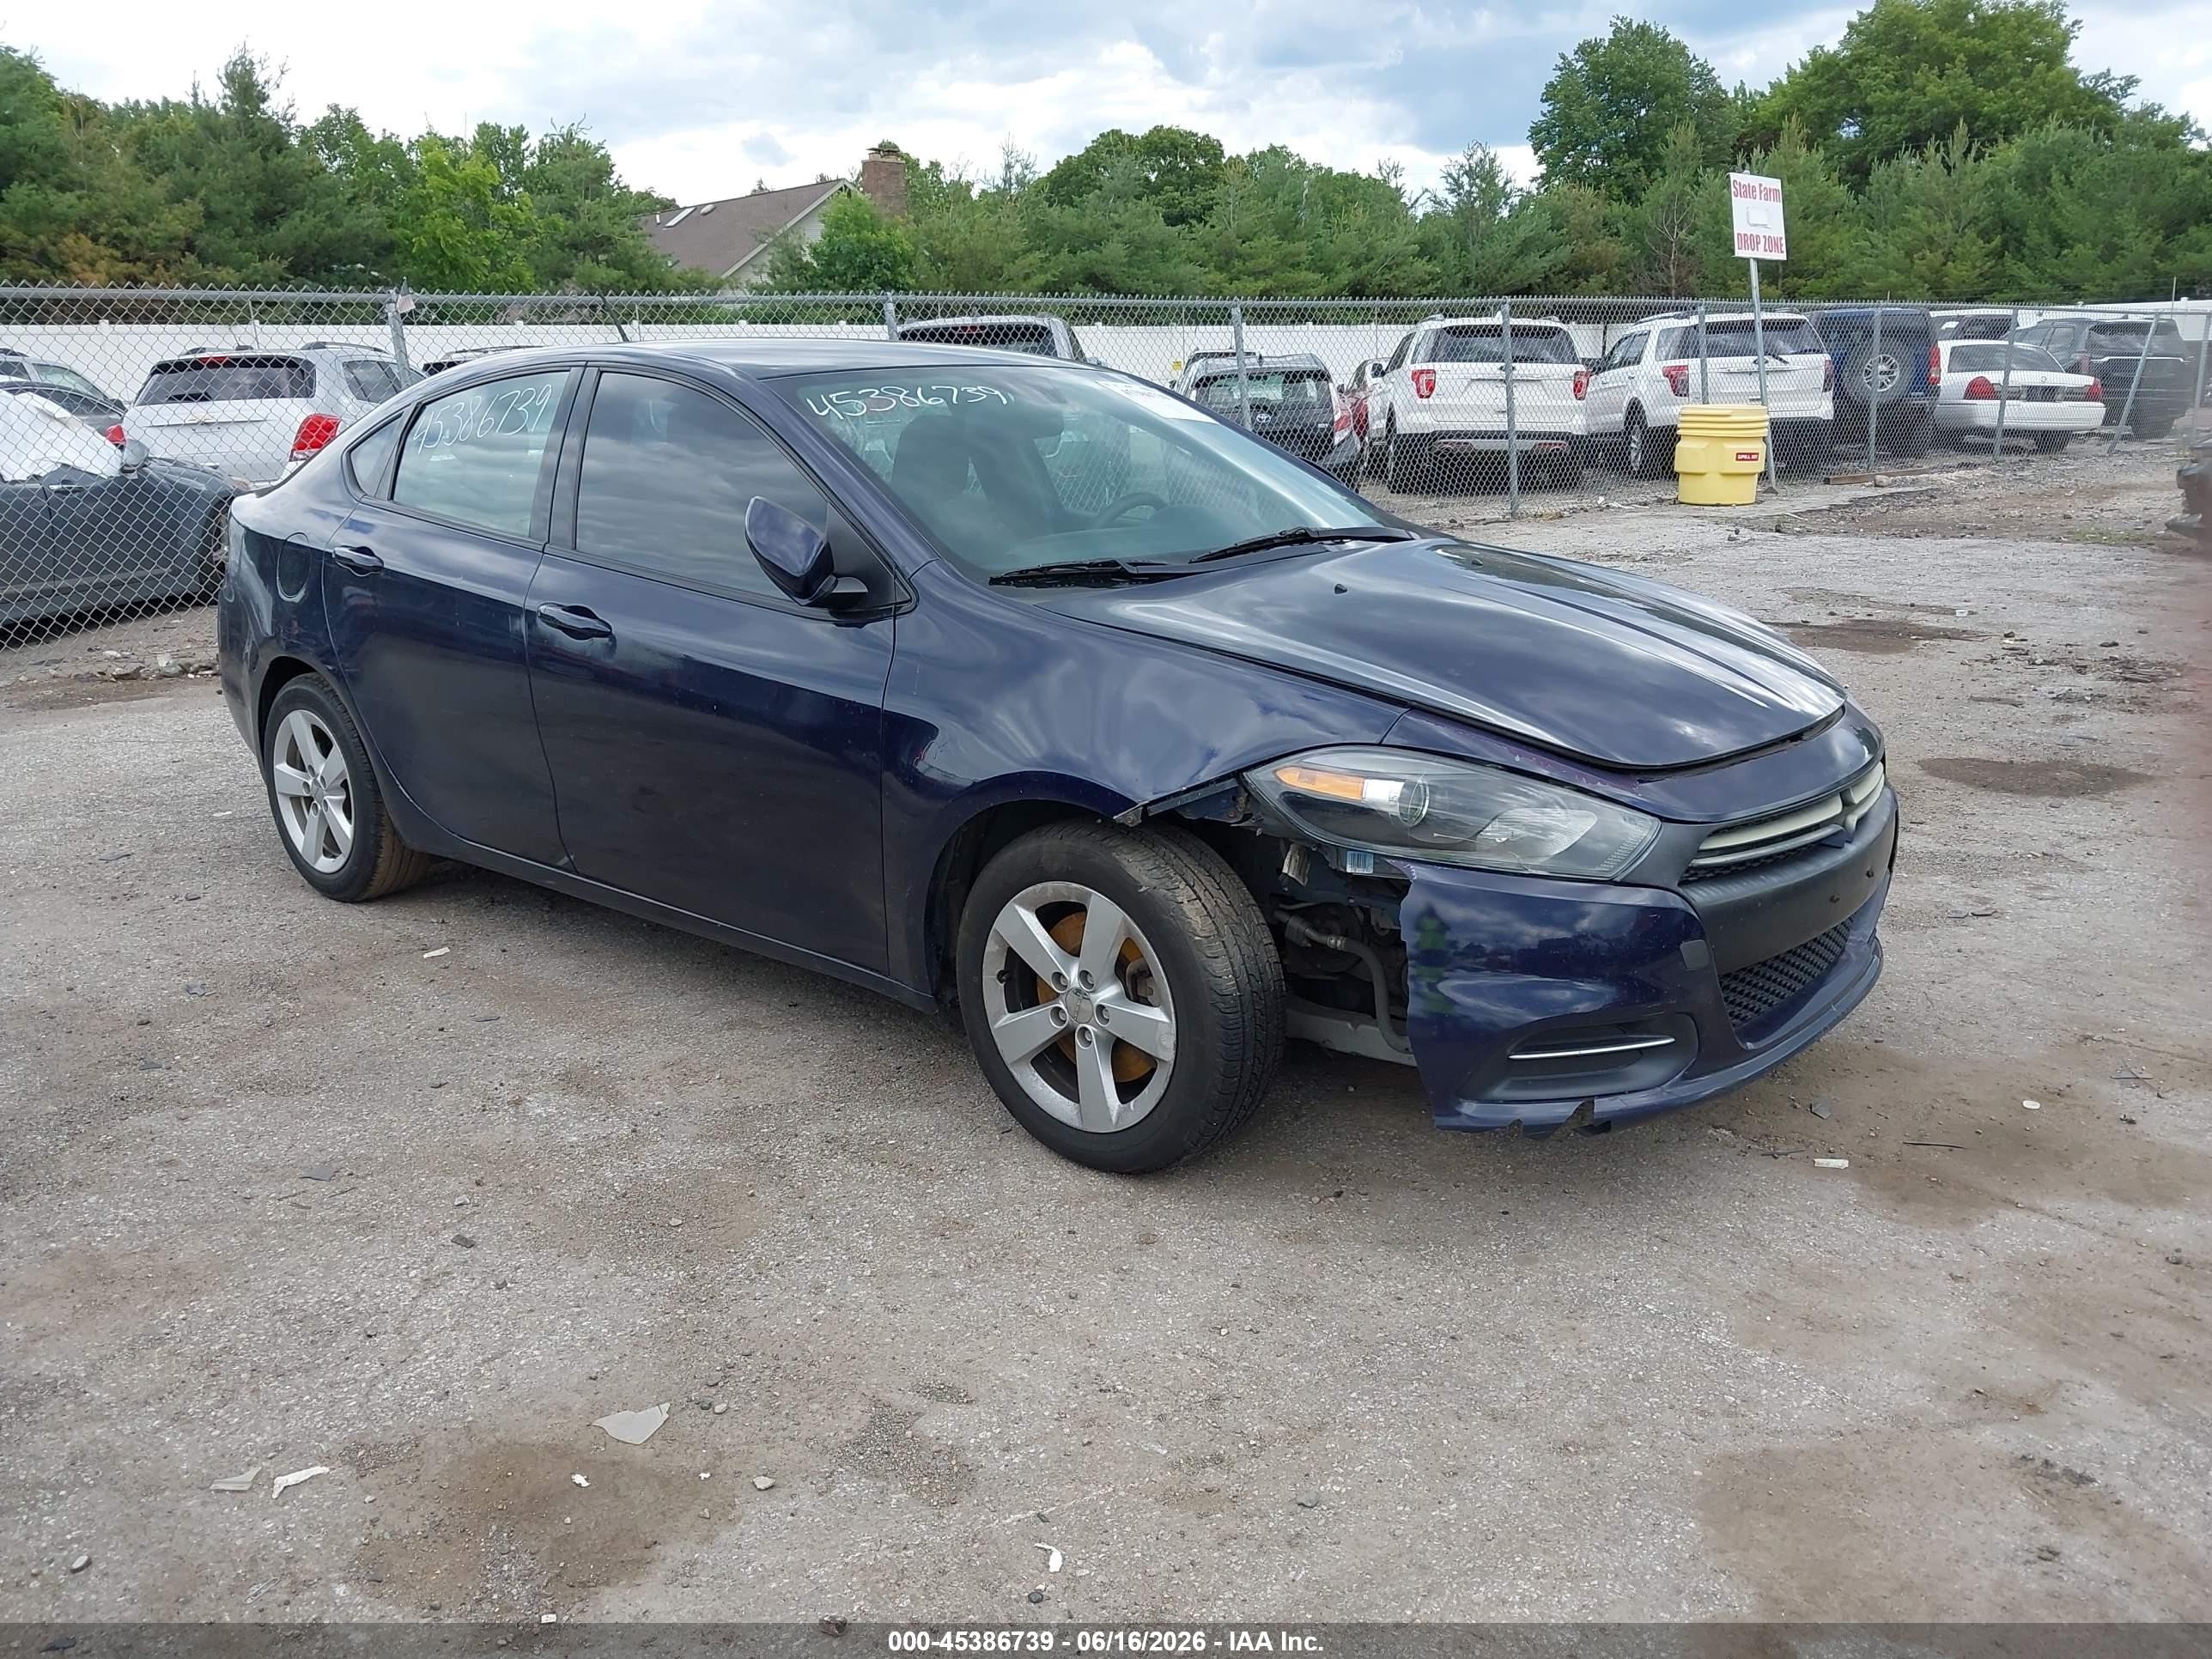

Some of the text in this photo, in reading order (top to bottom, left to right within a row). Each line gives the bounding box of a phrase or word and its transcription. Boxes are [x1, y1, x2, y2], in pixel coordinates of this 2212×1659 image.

[1733, 179, 1781, 203] State Farm
[1737, 233, 1784, 253] DROP ZONE
[805, 386, 1008, 420] 45386739
[413, 384, 552, 454] 45386739
